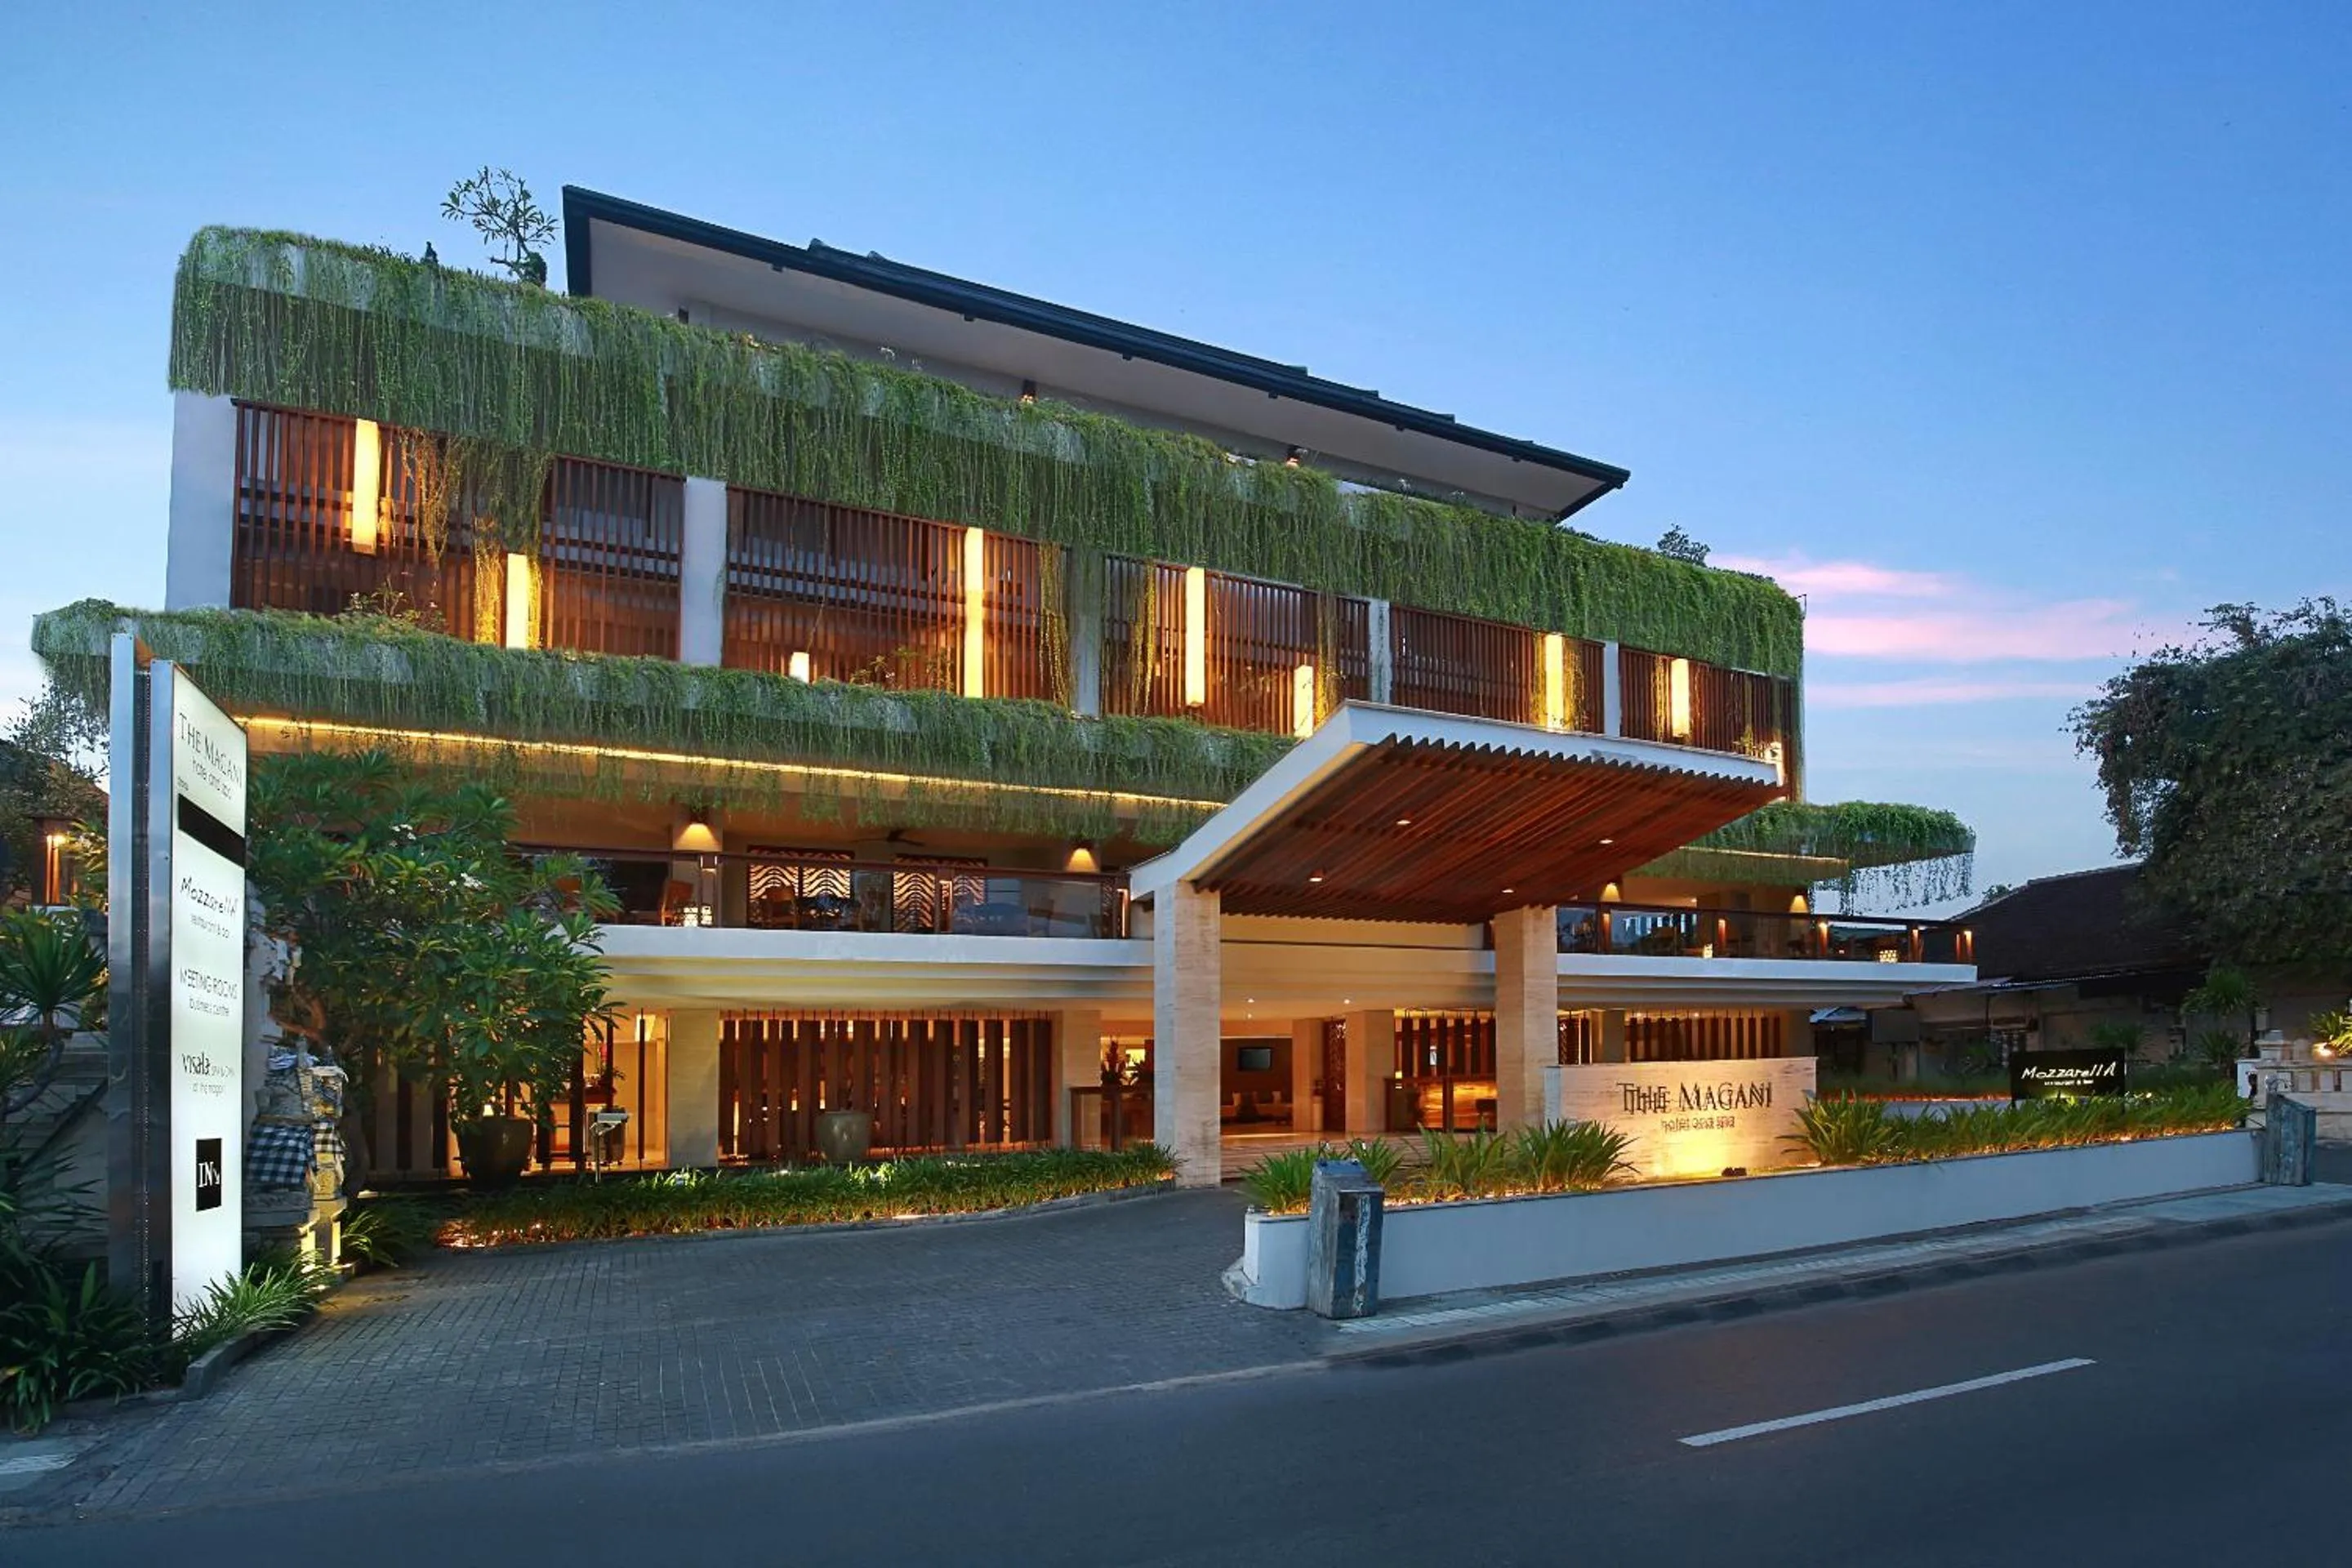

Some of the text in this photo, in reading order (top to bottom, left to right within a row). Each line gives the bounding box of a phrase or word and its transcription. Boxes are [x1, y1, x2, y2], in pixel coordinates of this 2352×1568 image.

[179, 712, 243, 789] THE MAGANI
[180, 967, 212, 993] MEETING
[1615, 1080, 1773, 1116] THE MAGANI
